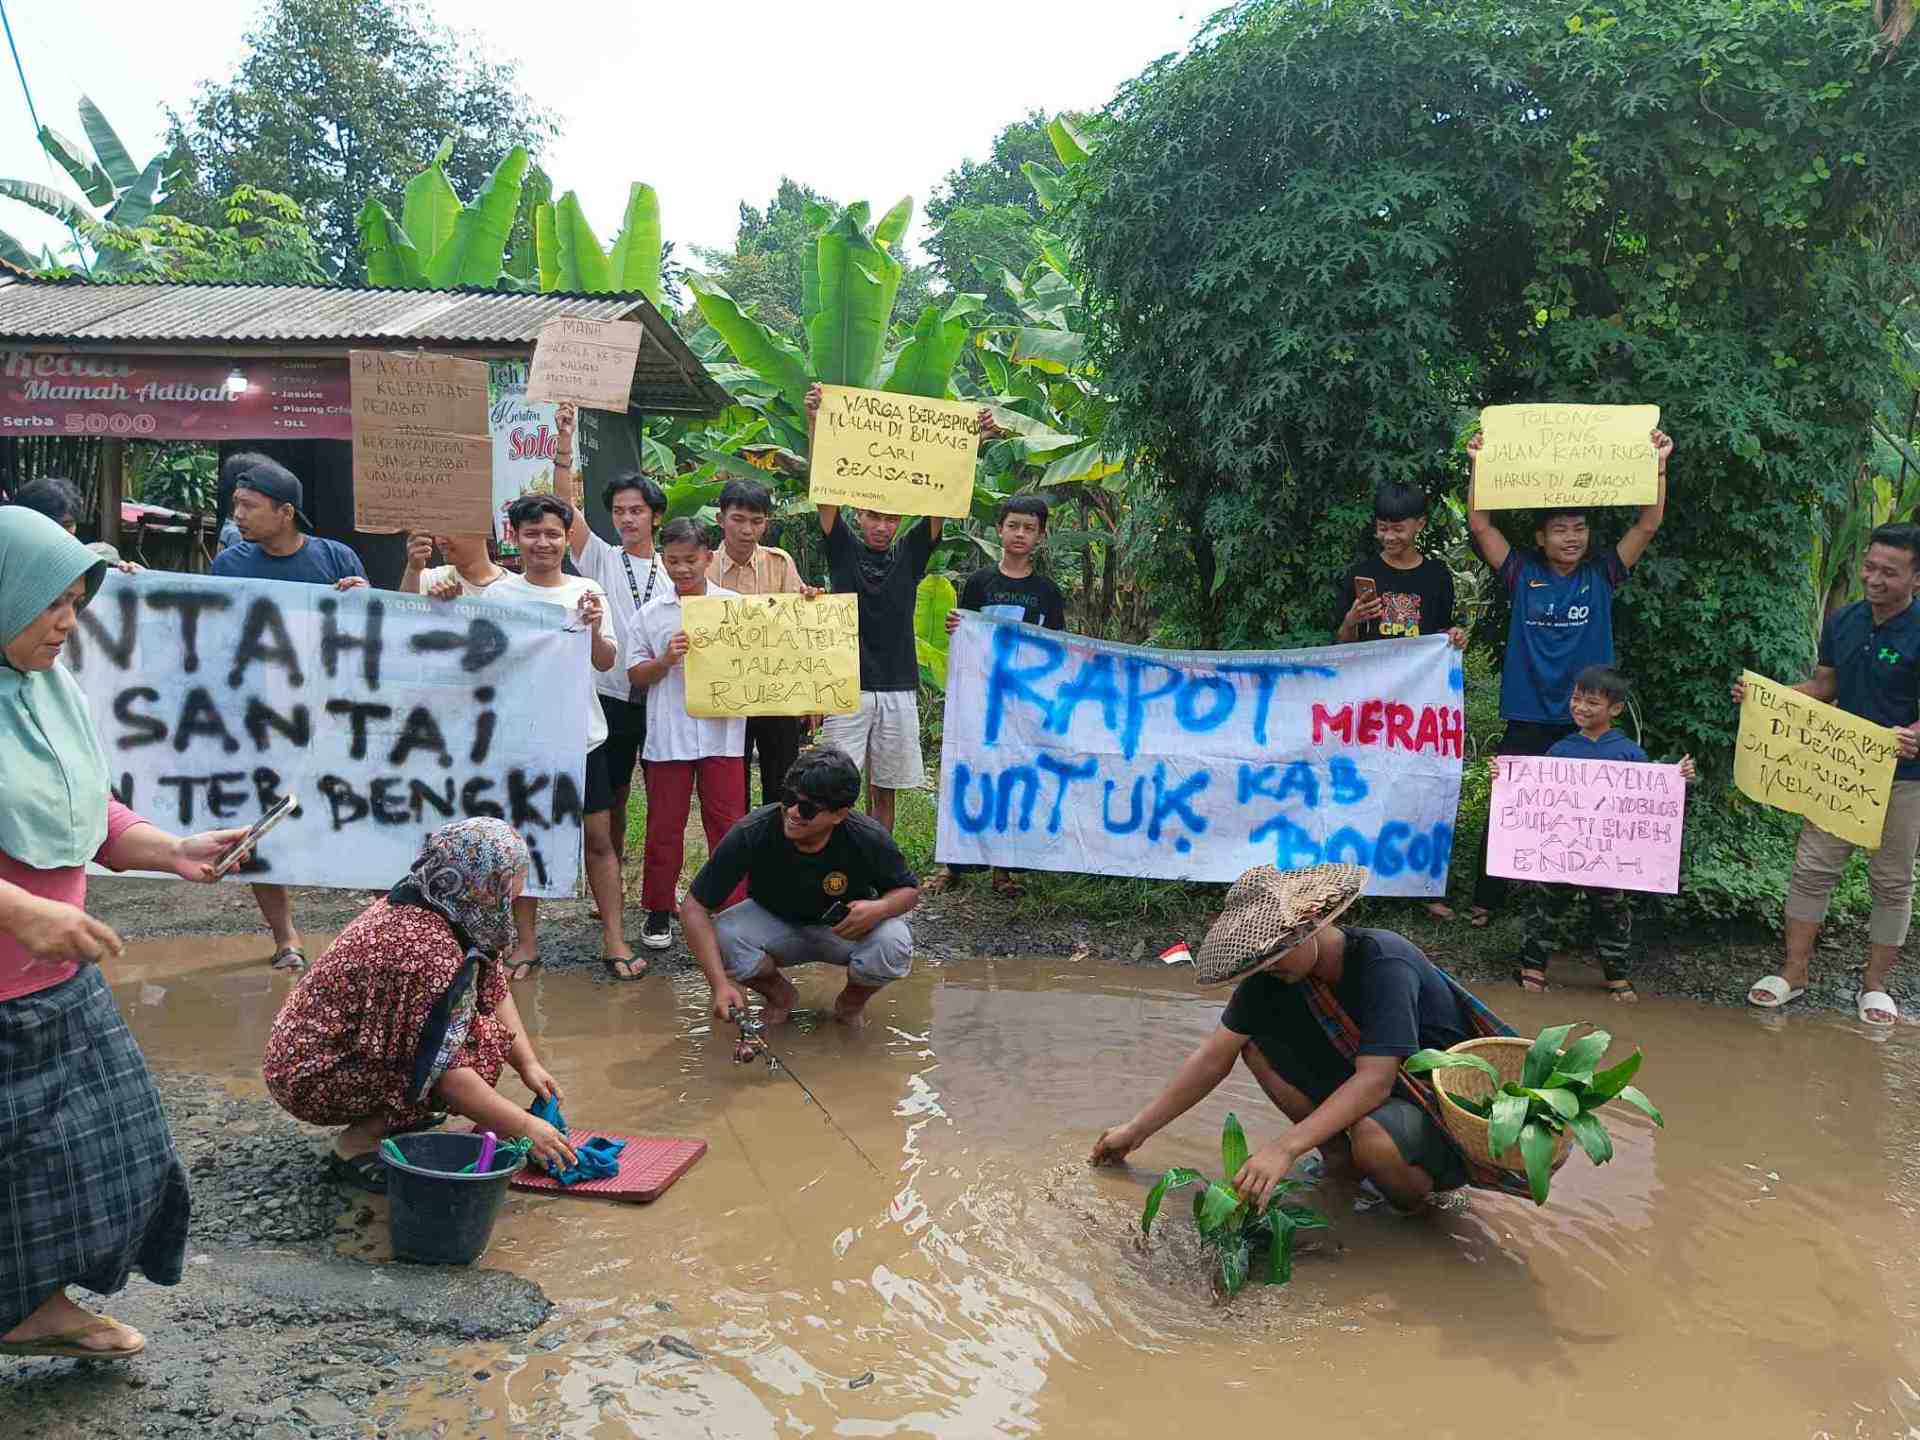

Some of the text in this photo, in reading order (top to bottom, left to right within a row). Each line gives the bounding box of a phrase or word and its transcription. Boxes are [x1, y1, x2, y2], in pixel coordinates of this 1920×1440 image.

[24, 380, 129, 400] Mamah
[282, 405, 324, 415] Pisang
[843, 395, 904, 420] WARGA
[2, 413, 156, 433] Serba 5000
[1518, 410, 1611, 428] TOLONG
[508, 425, 559, 461] Solo
[1540, 428, 1598, 447] DONG
[868, 442, 914, 462] CARI
[1487, 443, 1542, 463] JALAN
[1553, 443, 1603, 464] KAMI
[1494, 471, 1541, 490] HARUS
[1549, 472, 1565, 487] DI
[72, 586, 384, 691] NTAH
[709, 677, 854, 711] RUSAK
[983, 623, 1337, 760] RAPOT
[1311, 698, 1464, 759] MERAH
[1769, 718, 1792, 738] DI
[1505, 760, 1589, 786] TAHUN
[1515, 788, 1585, 810] MOAL
[1500, 806, 1596, 836] BUPATI
[1513, 848, 1643, 875] ENDAH
